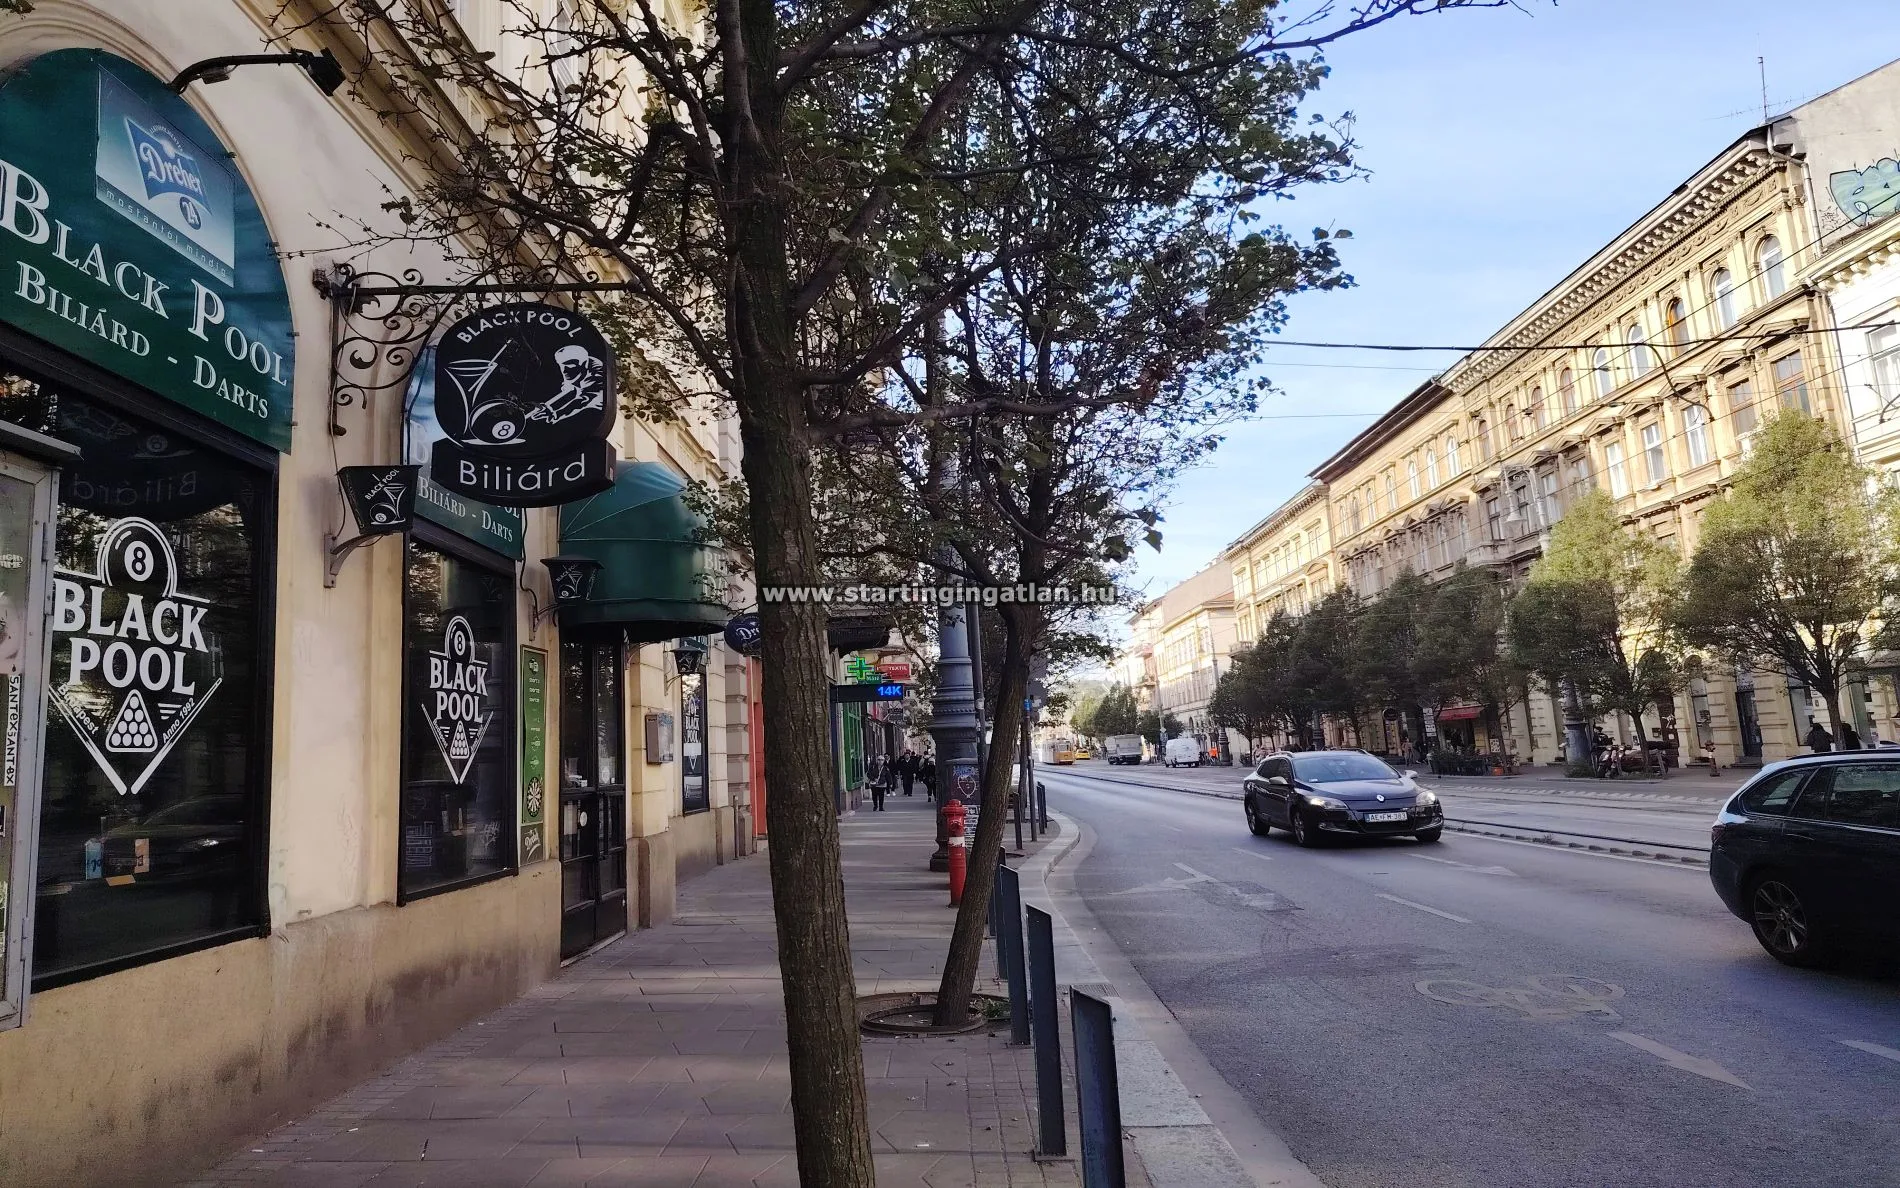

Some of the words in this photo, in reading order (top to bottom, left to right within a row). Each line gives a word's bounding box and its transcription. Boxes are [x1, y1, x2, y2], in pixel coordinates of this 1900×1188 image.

[140, 142, 203, 196] Dreher
[0, 158, 170, 320] BLACK
[188, 278, 288, 387] POOL
[186, 244, 227, 278] mindig
[15, 260, 151, 359] BILIÁRD
[192, 354, 269, 420] DARTS
[456, 310, 521, 345] BLACK
[527, 310, 583, 340] POOL
[459, 453, 587, 493] Biliárd
[417, 475, 466, 518] BILIÁRD
[481, 509, 513, 543] DARTS
[53, 578, 210, 654] BLACK
[69, 636, 196, 697] POOL
[429, 656, 488, 697] BLACK
[436, 690, 484, 724] POOL
[877, 685, 903, 696] 14K
[162, 718, 181, 744] Anno
[179, 697, 196, 720] 1992
